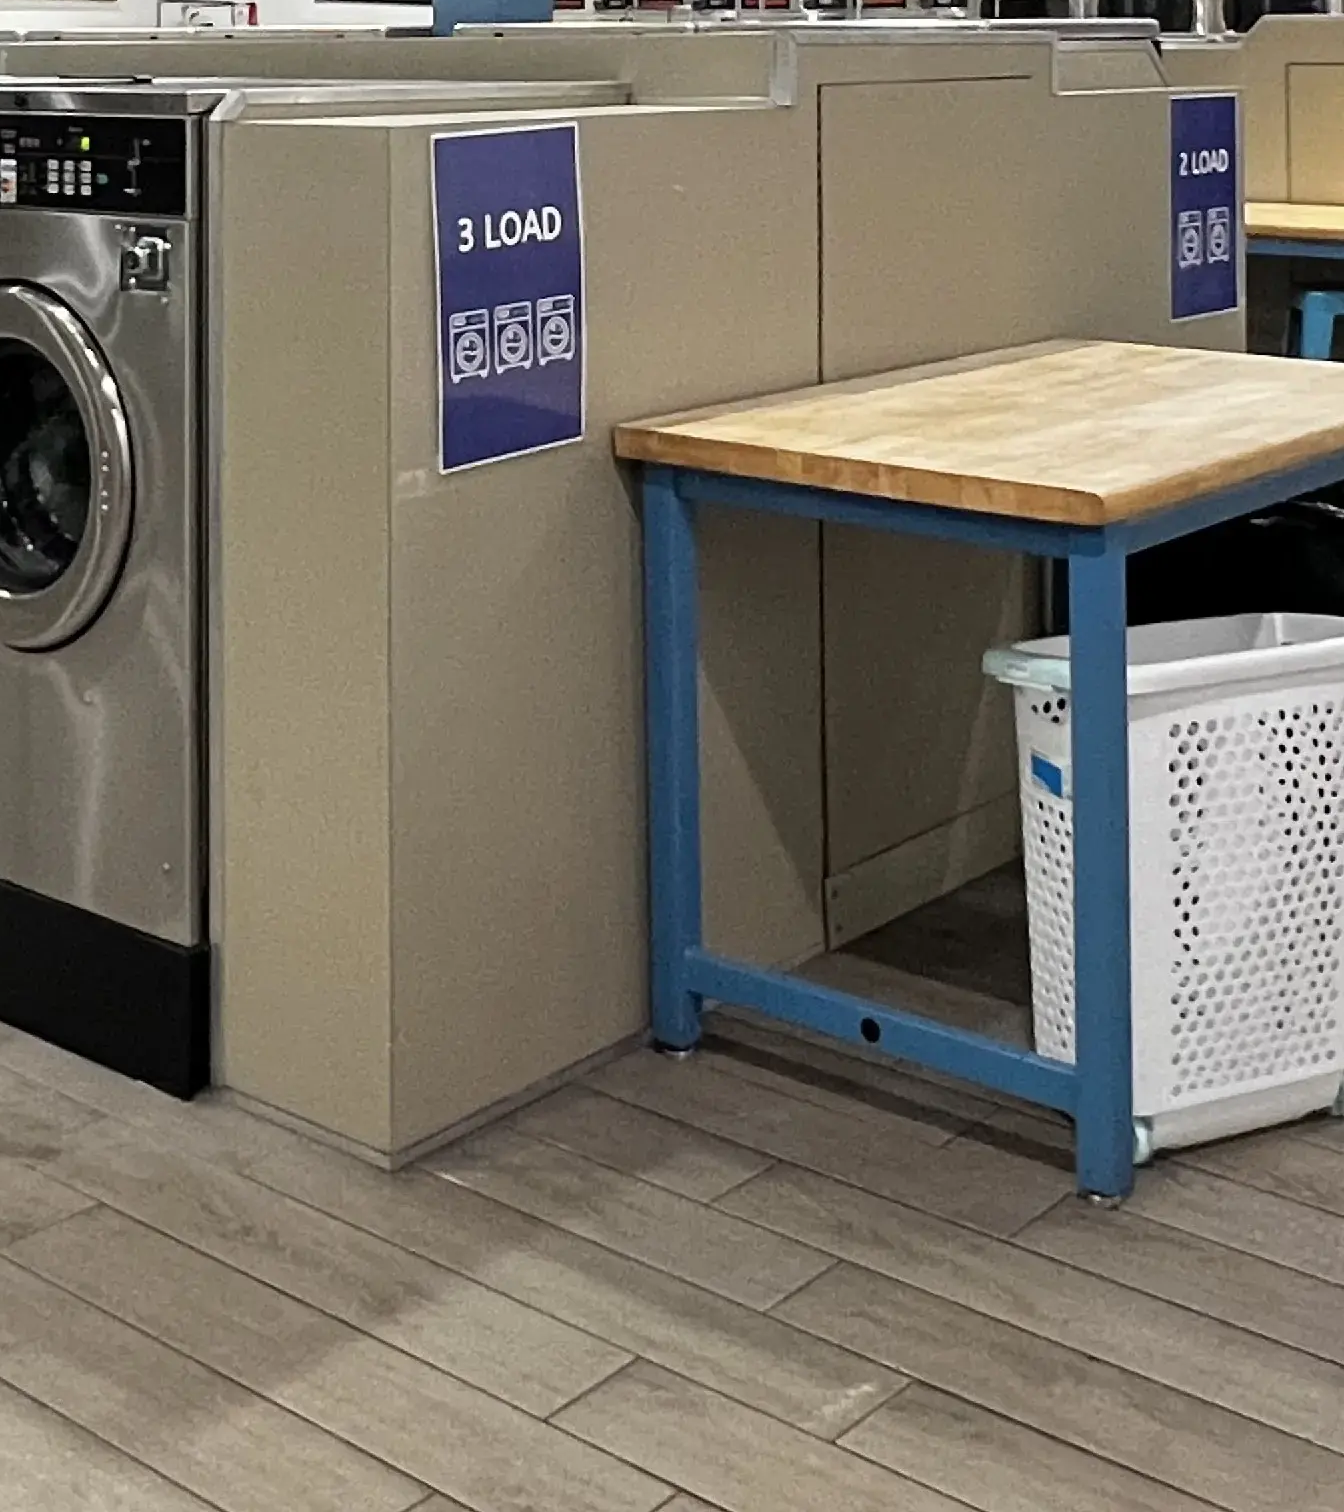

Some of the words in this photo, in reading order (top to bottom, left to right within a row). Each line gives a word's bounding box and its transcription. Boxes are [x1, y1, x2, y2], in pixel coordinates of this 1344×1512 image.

[1179, 152, 1188, 176] 2
[1192, 149, 1229, 175] LOAD
[457, 218, 474, 253] 3
[484, 206, 561, 249] LOAD
